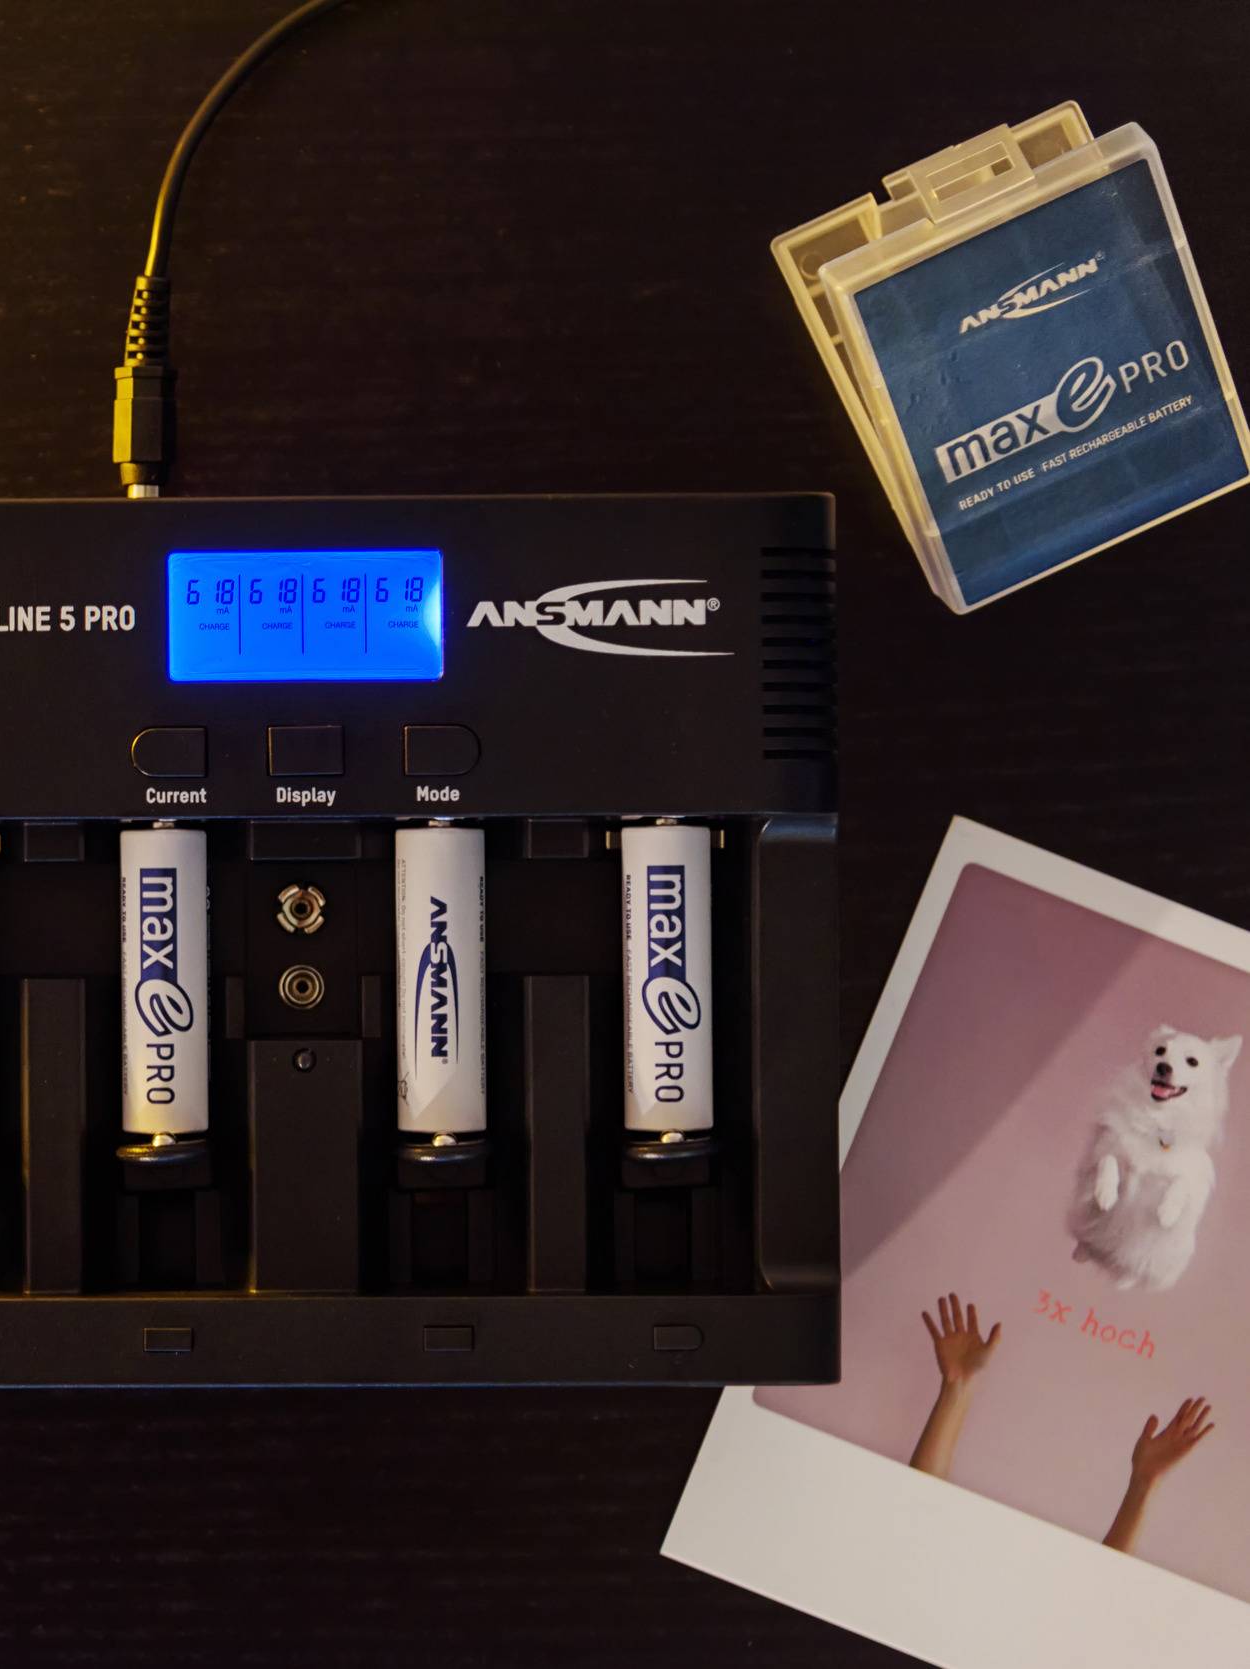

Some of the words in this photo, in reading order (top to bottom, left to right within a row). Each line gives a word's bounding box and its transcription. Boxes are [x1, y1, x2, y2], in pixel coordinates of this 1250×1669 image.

[1118, 339, 1190, 395] PRO
[958, 487, 994, 511] READY
[996, 479, 1012, 494] TO
[1013, 467, 1036, 486] USE
[1041, 452, 1068, 473] FAST
[1069, 416, 1148, 460] RECHARGEABLE
[1148, 395, 1193, 423] BATTERY
[216, 607, 230, 615] mA
[279, 606, 293, 614] mA
[342, 605, 356, 613] mA
[405, 604, 419, 613] mA
[59, 605, 76, 632] 5
[83, 605, 136, 631] PRO
[324, 621, 356, 630] CHARGE
[388, 620, 420, 629] CHARGE
[199, 622, 230, 631] CHARGE
[261, 622, 293, 630] CHARGE
[145, 787, 208, 804] Current
[276, 786, 337, 807] Display
[416, 786, 460, 802] Mode
[626, 908, 632, 920] TO
[145, 1043, 175, 1106] PRO
[654, 1040, 684, 1103] PRO
[1080, 1308, 1156, 1359] hoch
